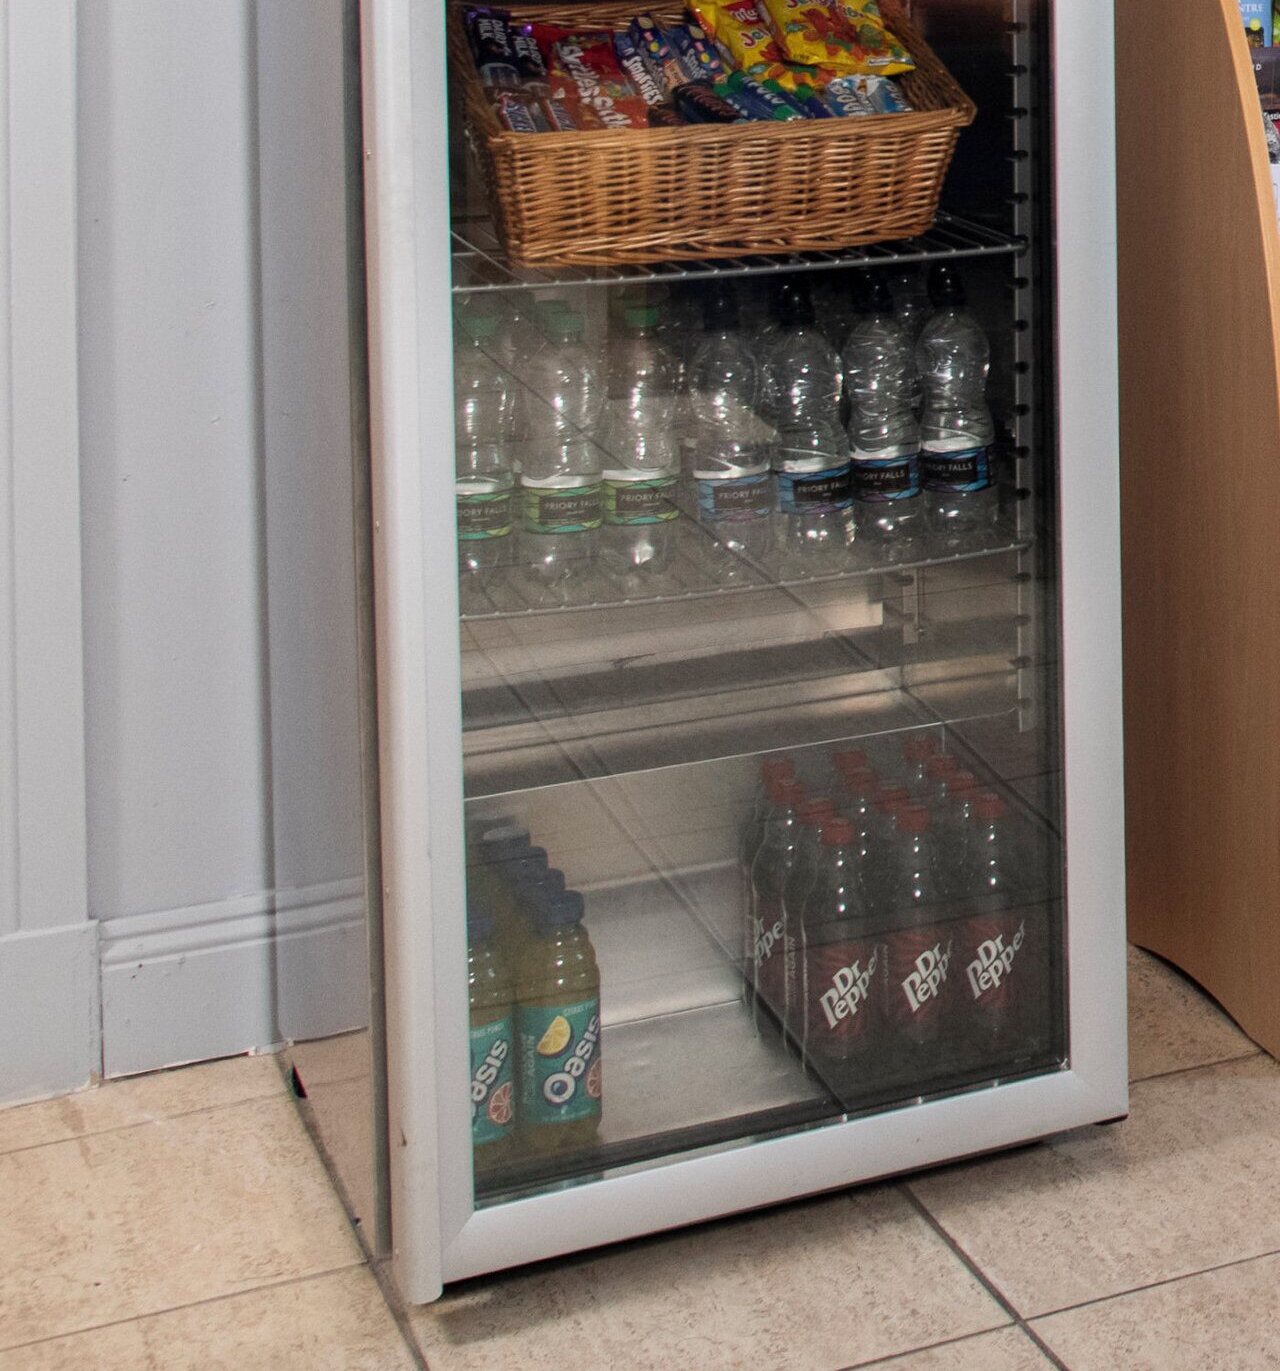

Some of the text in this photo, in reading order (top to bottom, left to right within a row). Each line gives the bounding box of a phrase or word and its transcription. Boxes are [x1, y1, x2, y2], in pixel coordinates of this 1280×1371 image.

[914, 941, 942, 980] Dr
[976, 933, 1005, 968] Dr
[832, 959, 861, 994] Dr
[472, 1038, 509, 1103] asis
